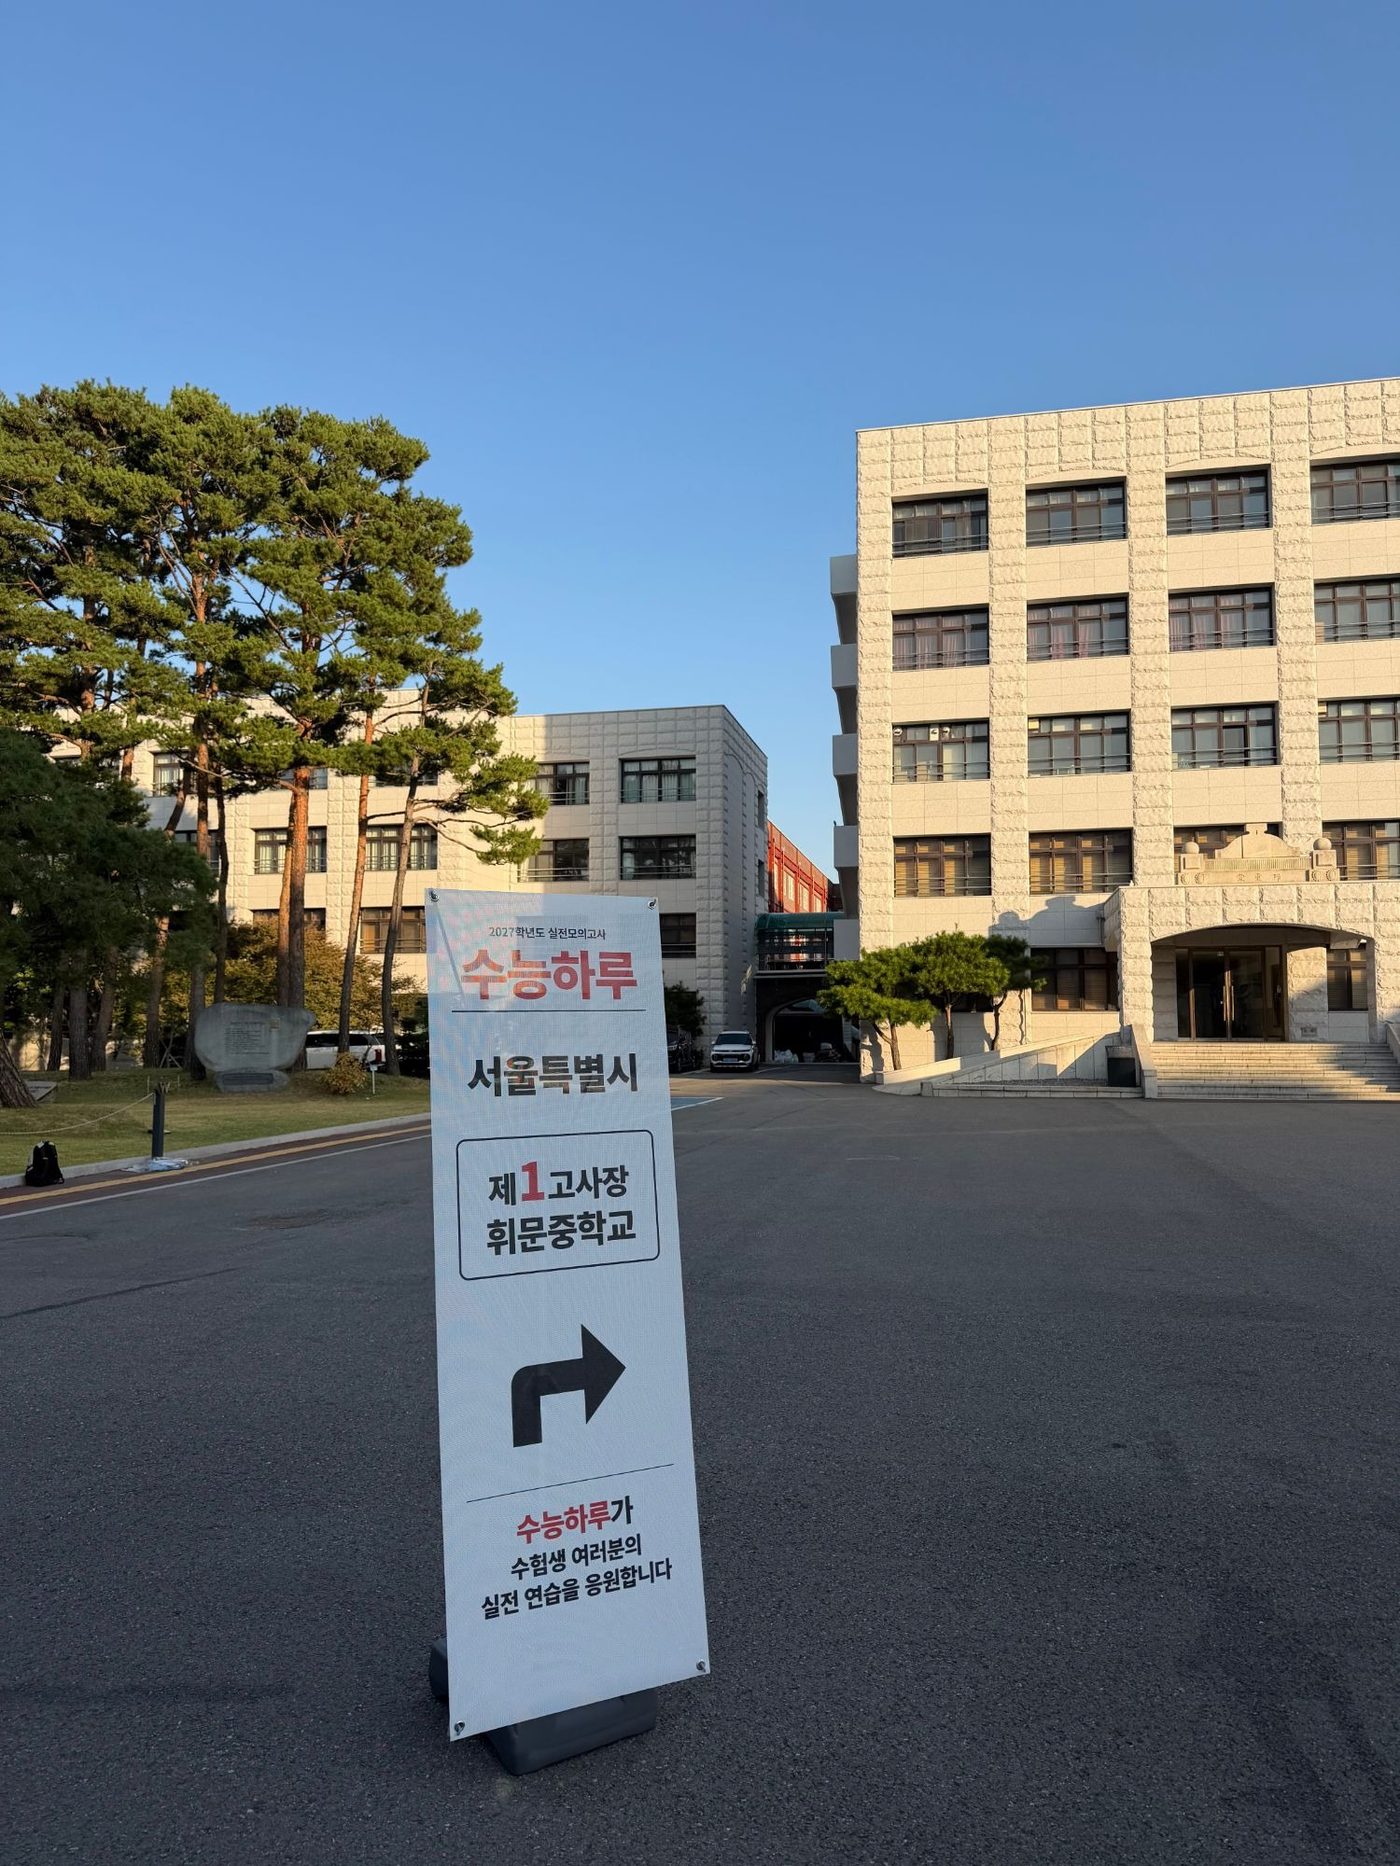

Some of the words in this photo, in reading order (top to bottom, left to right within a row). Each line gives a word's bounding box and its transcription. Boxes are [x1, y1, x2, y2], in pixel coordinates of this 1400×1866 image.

[489, 927, 545, 939] 2027학년도
[548, 927, 606, 940] 실전모의고사
[461, 949, 638, 1000] 수능하루
[467, 1053, 638, 1097] 서울특별시
[487, 1210, 636, 1256] 휘문중학교
[516, 1495, 634, 1544] 수능하루가
[511, 1548, 567, 1581] 수험생
[571, 1533, 642, 1567] 여러분의
[481, 1589, 519, 1620] 실전
[524, 1577, 580, 1610] 연습을
[584, 1557, 673, 1597] 응원합니다
